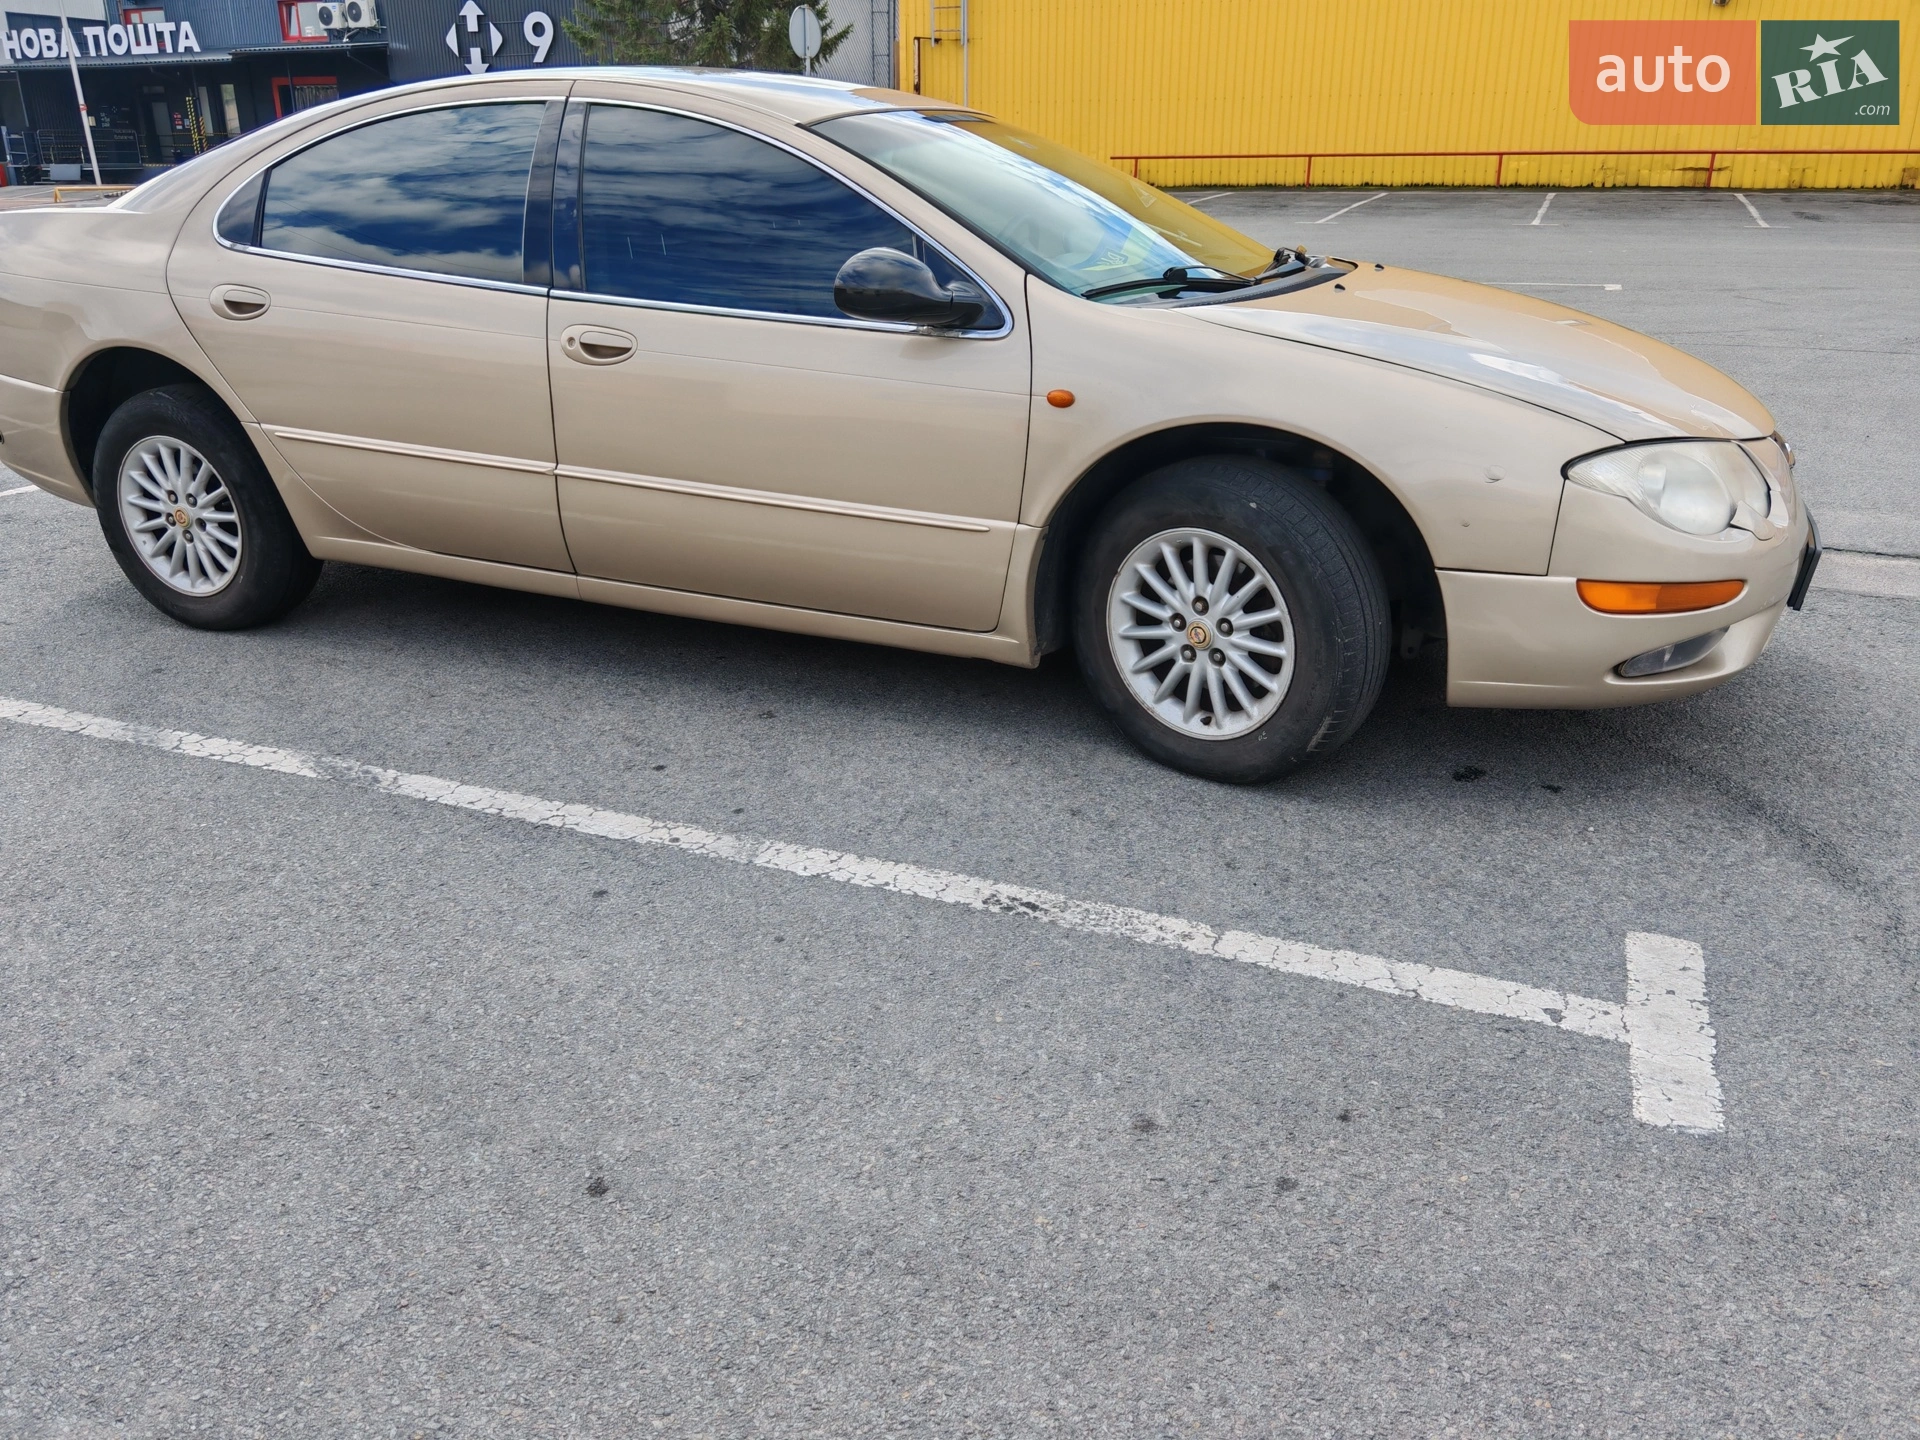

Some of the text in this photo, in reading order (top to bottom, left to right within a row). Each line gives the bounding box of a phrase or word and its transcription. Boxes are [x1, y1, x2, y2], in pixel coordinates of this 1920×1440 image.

[1, 21, 201, 60] НОВА ПОШТА
[523, 11, 554, 63] 9
